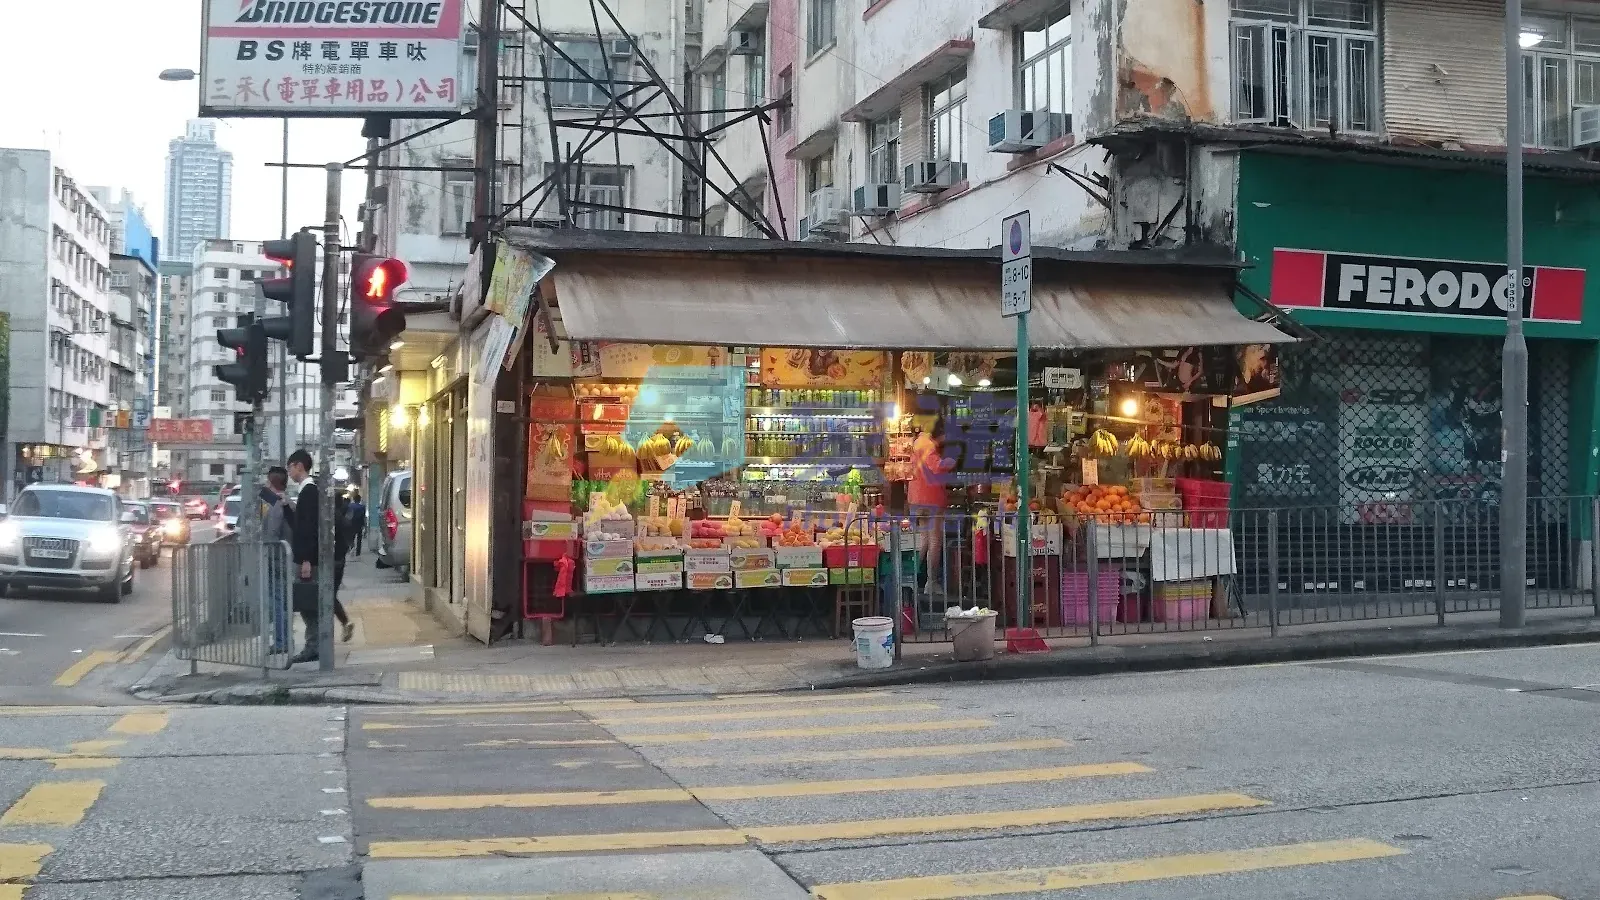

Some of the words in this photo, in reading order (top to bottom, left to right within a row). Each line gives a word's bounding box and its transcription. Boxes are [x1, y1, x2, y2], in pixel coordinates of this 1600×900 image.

[235, 1, 439, 24] BRIDGESTONE
[236, 40, 428, 62] BS牌電單車呔
[302, 63, 362, 75] 特約經銷商
[1013, 291, 1026, 306] 5-7
[1353, 437, 1390, 449] ROCK
